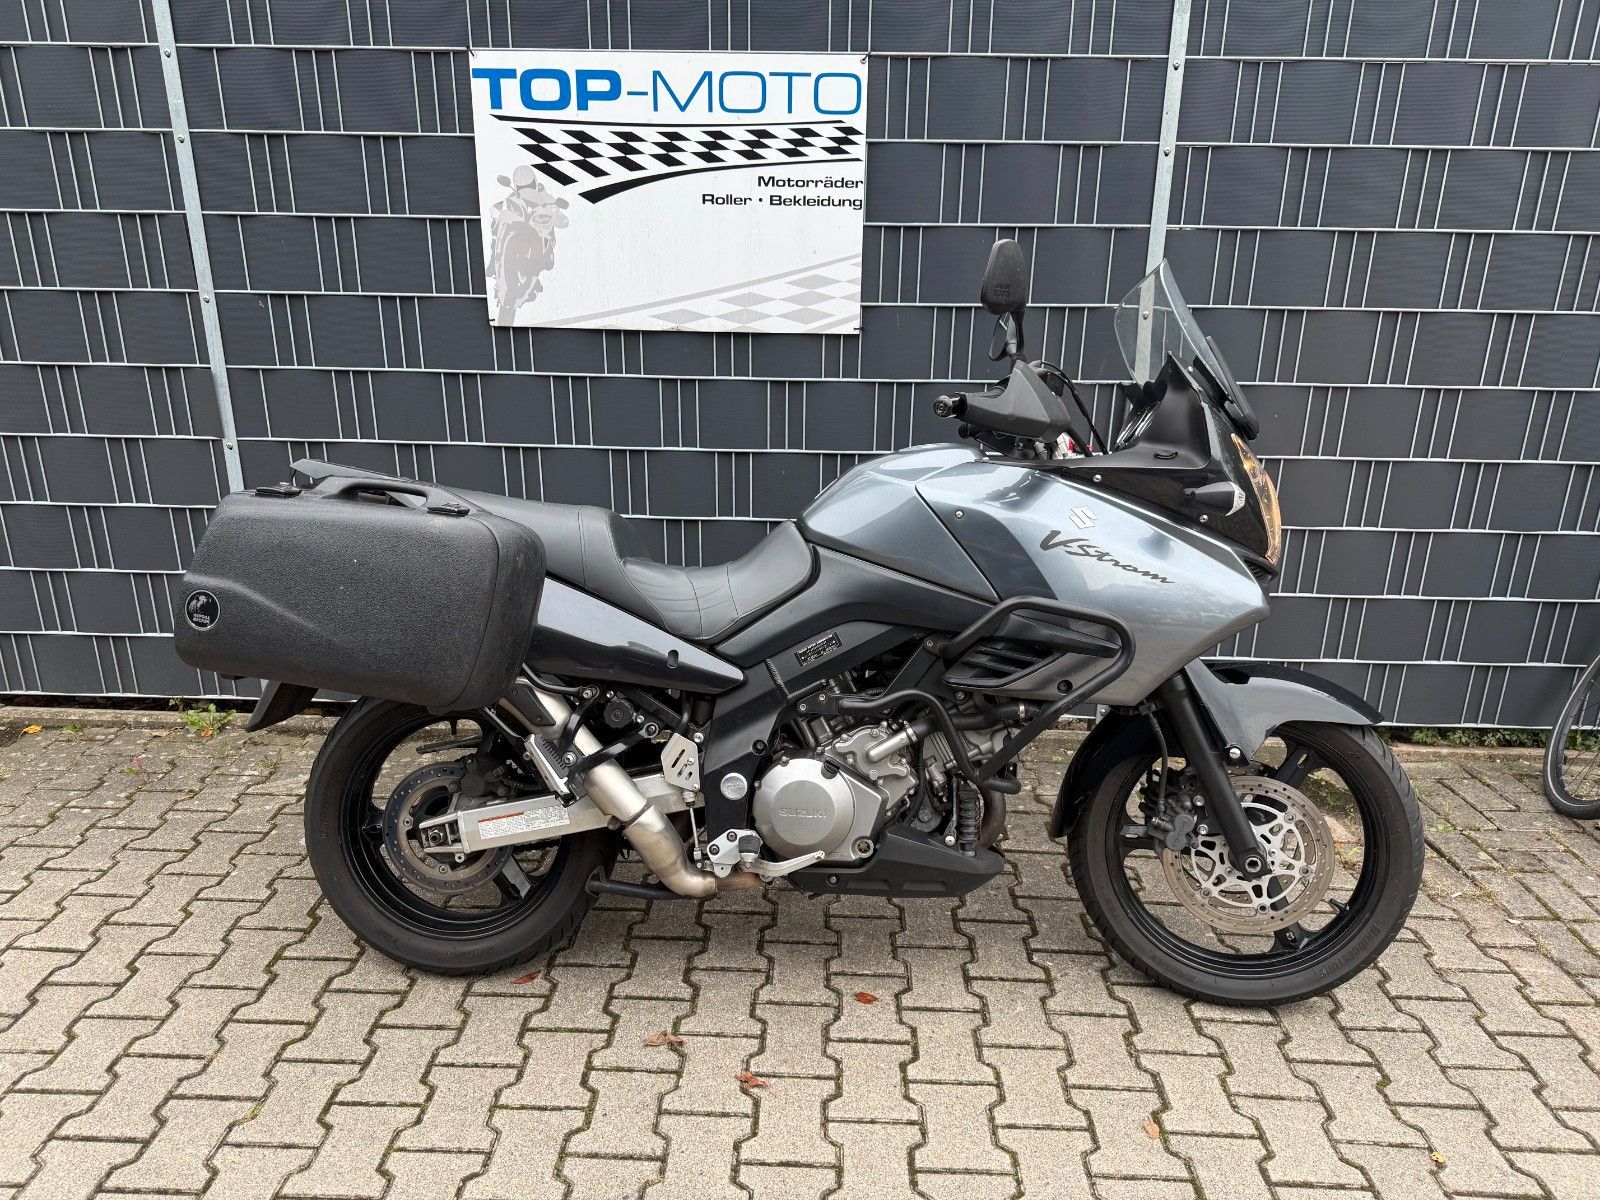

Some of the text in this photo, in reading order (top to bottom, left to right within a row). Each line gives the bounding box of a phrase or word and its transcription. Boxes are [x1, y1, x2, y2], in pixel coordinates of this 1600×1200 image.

[472, 68, 862, 115] TOP-MOTO
[757, 175, 864, 190] Motorräder
[701, 193, 863, 210] Roller Bekleidung
[778, 808, 827, 818] SUZUKI
